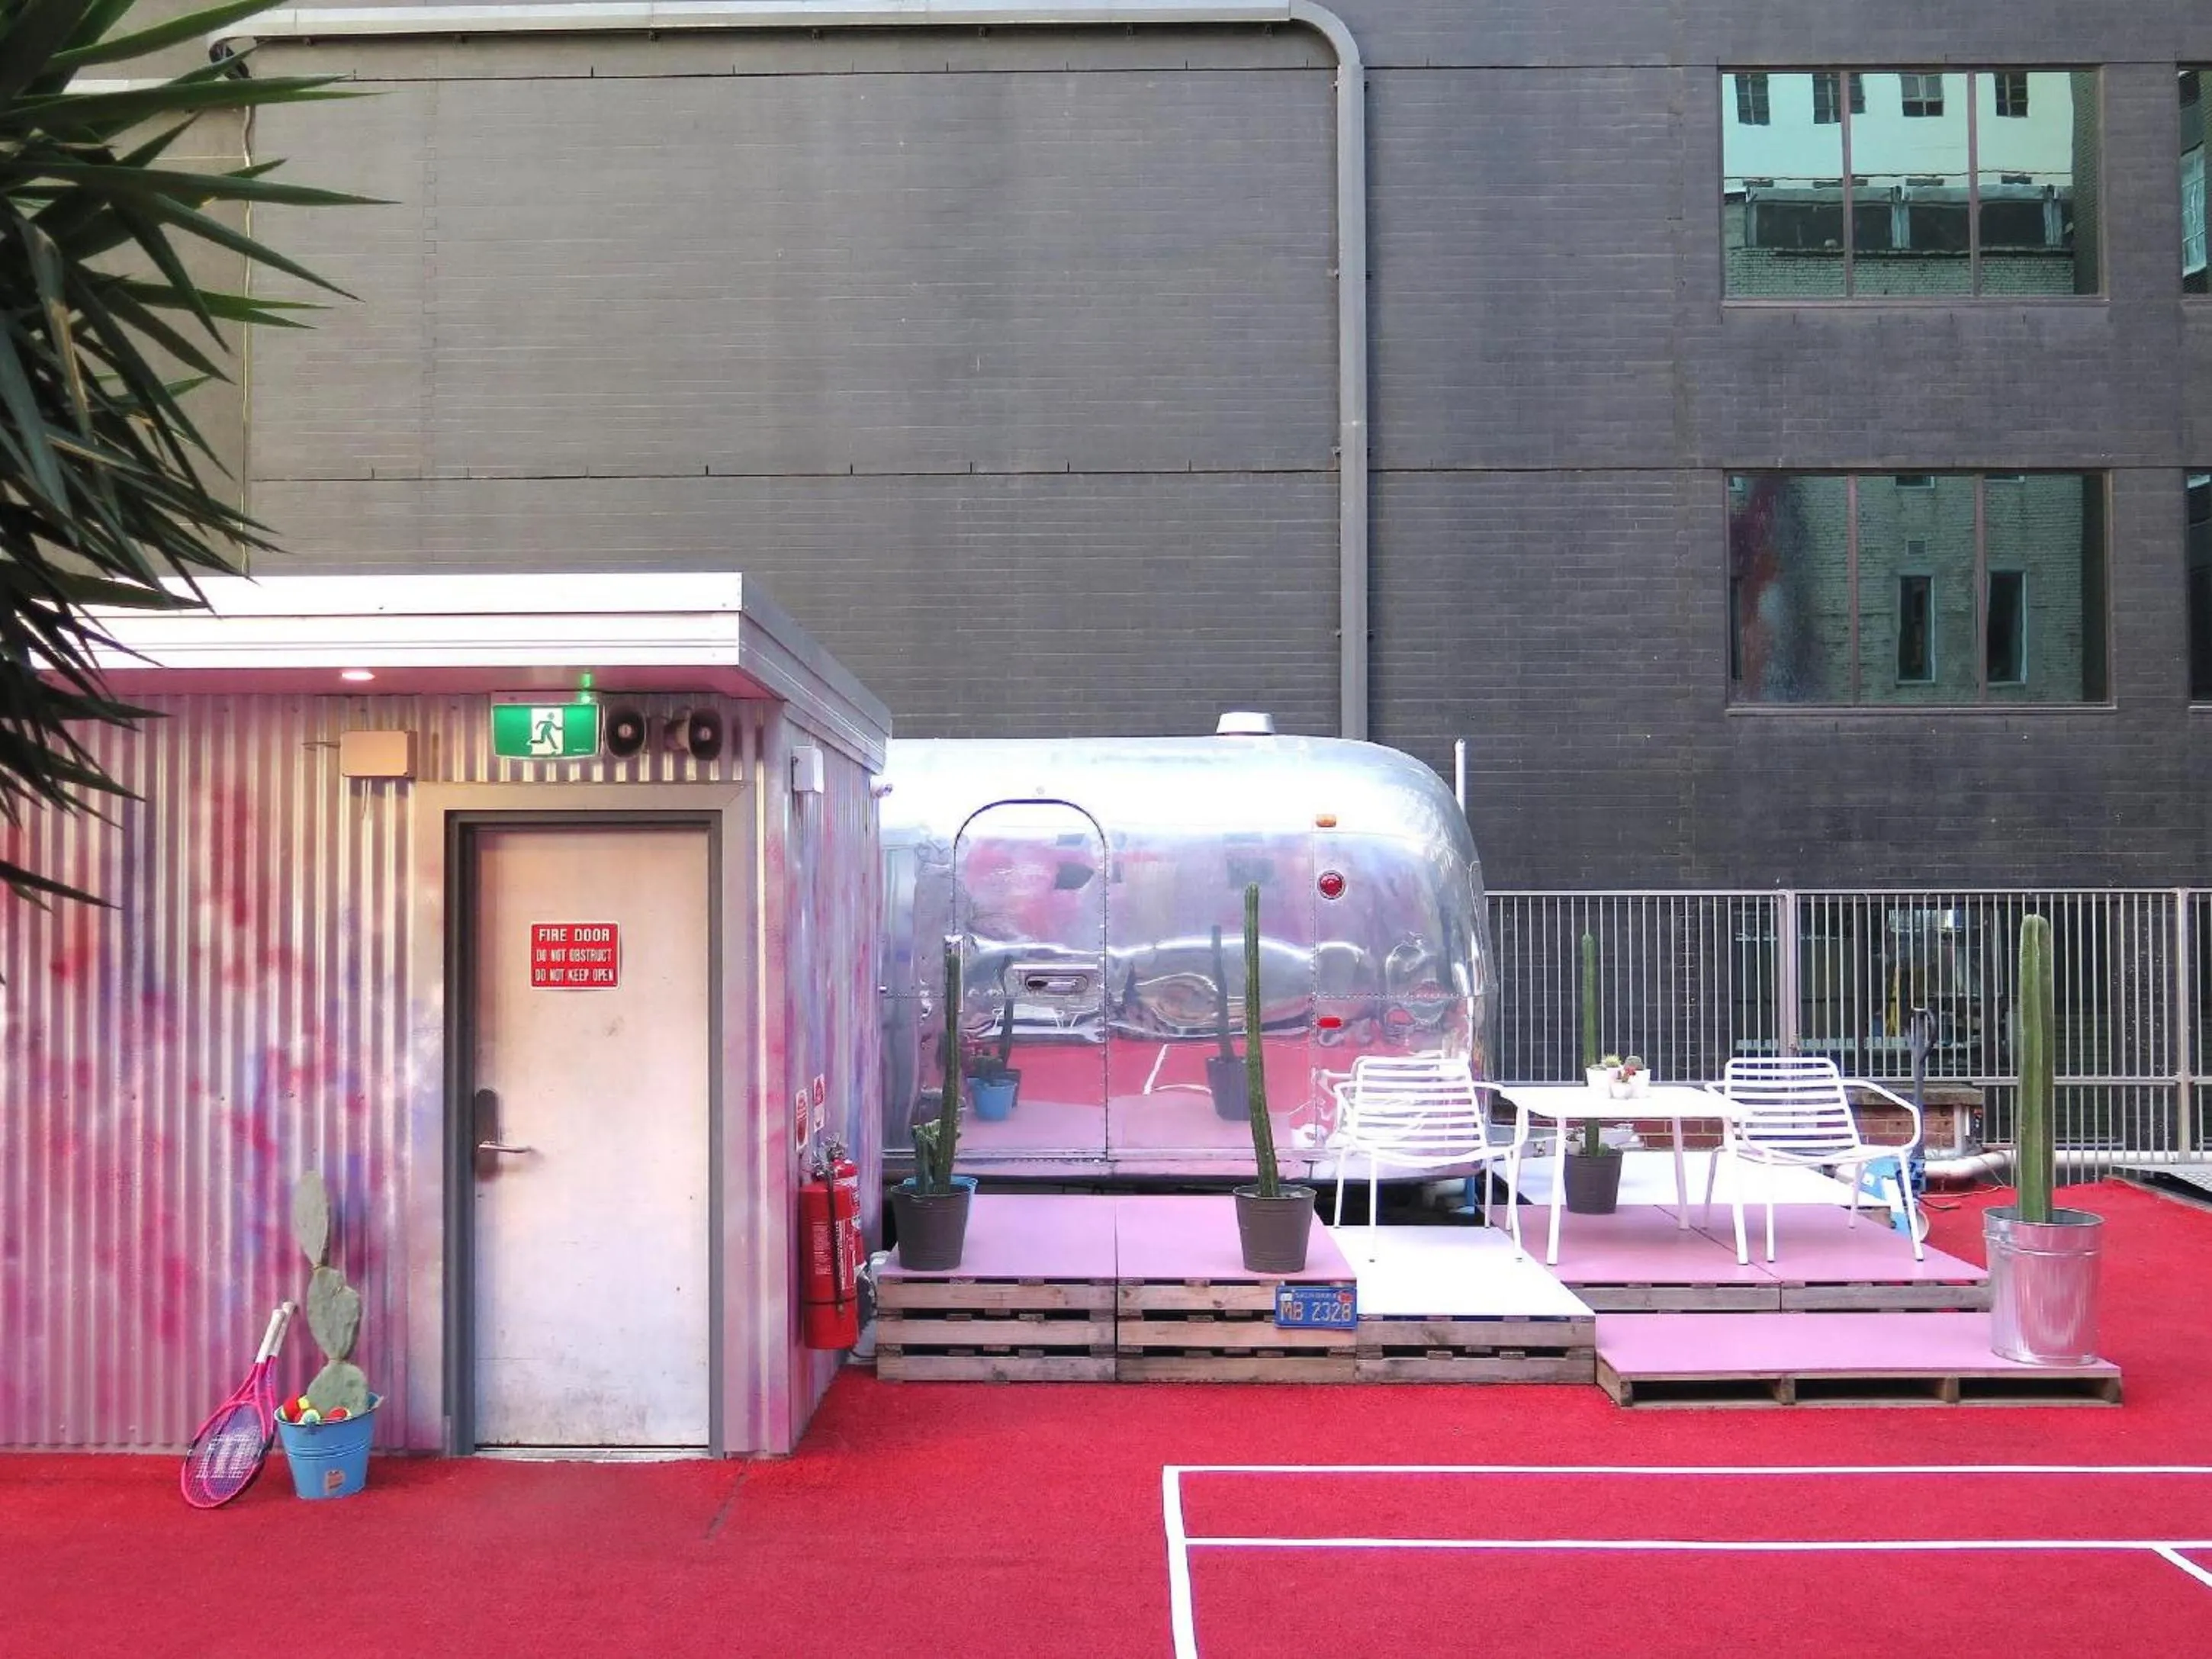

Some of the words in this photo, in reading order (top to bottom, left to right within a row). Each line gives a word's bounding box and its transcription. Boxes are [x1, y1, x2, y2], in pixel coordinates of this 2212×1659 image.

[539, 928, 567, 941] FIRE
[574, 928, 609, 941] DOOR
[536, 948, 547, 962] DO
[551, 948, 566, 962] NOT
[569, 948, 612, 962] OBSTRUCT
[535, 968, 546, 982] DO
[549, 968, 564, 982] NOT
[567, 968, 590, 982] KEEP
[593, 968, 614, 982] OPEN
[1311, 1301, 1352, 1322] 2328
